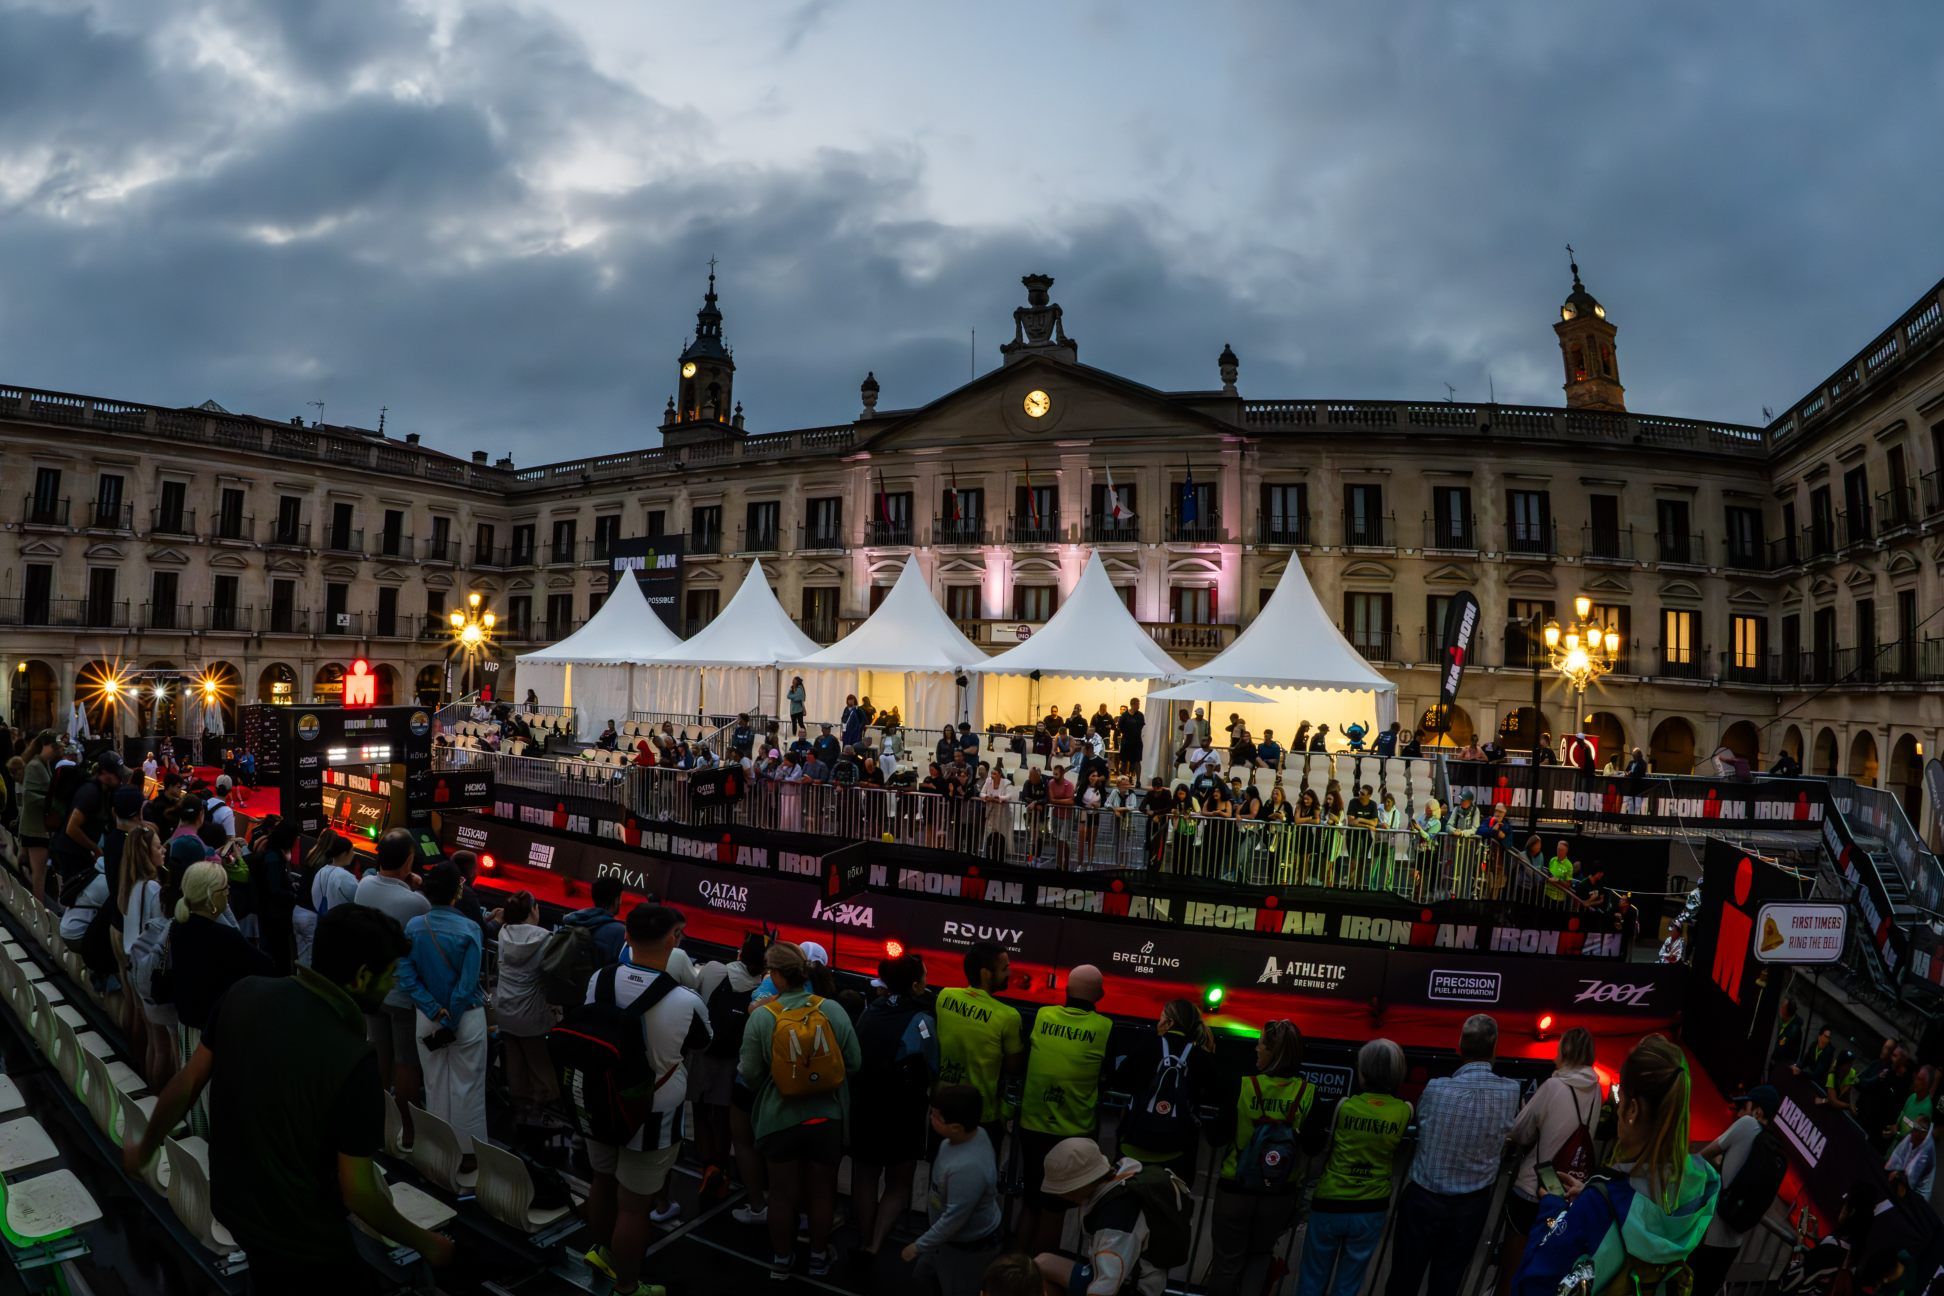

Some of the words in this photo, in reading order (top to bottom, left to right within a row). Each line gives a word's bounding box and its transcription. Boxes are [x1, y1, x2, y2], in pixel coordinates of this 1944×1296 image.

[614, 548, 677, 571] IRONMAN
[484, 661, 499, 672] VIP
[465, 783, 487, 791] HOKA
[1657, 788, 1746, 820] IRONMAN
[458, 826, 488, 841] EUSKADI
[699, 879, 749, 903] QATAR
[708, 896, 747, 913] AIRWAYS
[898, 866, 1024, 905] IRONMAN
[1036, 879, 1172, 921] IRONMAN
[1183, 896, 1327, 936] IRONMAN
[1339, 908, 1479, 950] IRONMAN
[1490, 917, 1622, 957] IRONMAN
[1791, 916, 1813, 929] FIRST
[1814, 916, 1842, 930] TIMERS
[943, 920, 1024, 944] ROUVY
[1788, 935, 1808, 950] RING
[1808, 936, 1822, 950] THE
[1822, 936, 1839, 950] BELL
[1112, 951, 1180, 968] BREITLING
[1135, 965, 1154, 974] 1884
[1285, 961, 1347, 980] ATHLETIC
[1293, 978, 1325, 989] BREWING
[1435, 976, 1496, 989] PRECISION
[1434, 986, 1452, 995] FUEL
[1457, 987, 1494, 997] HYDRATION
[1777, 1095, 1828, 1160] NIRVANA
